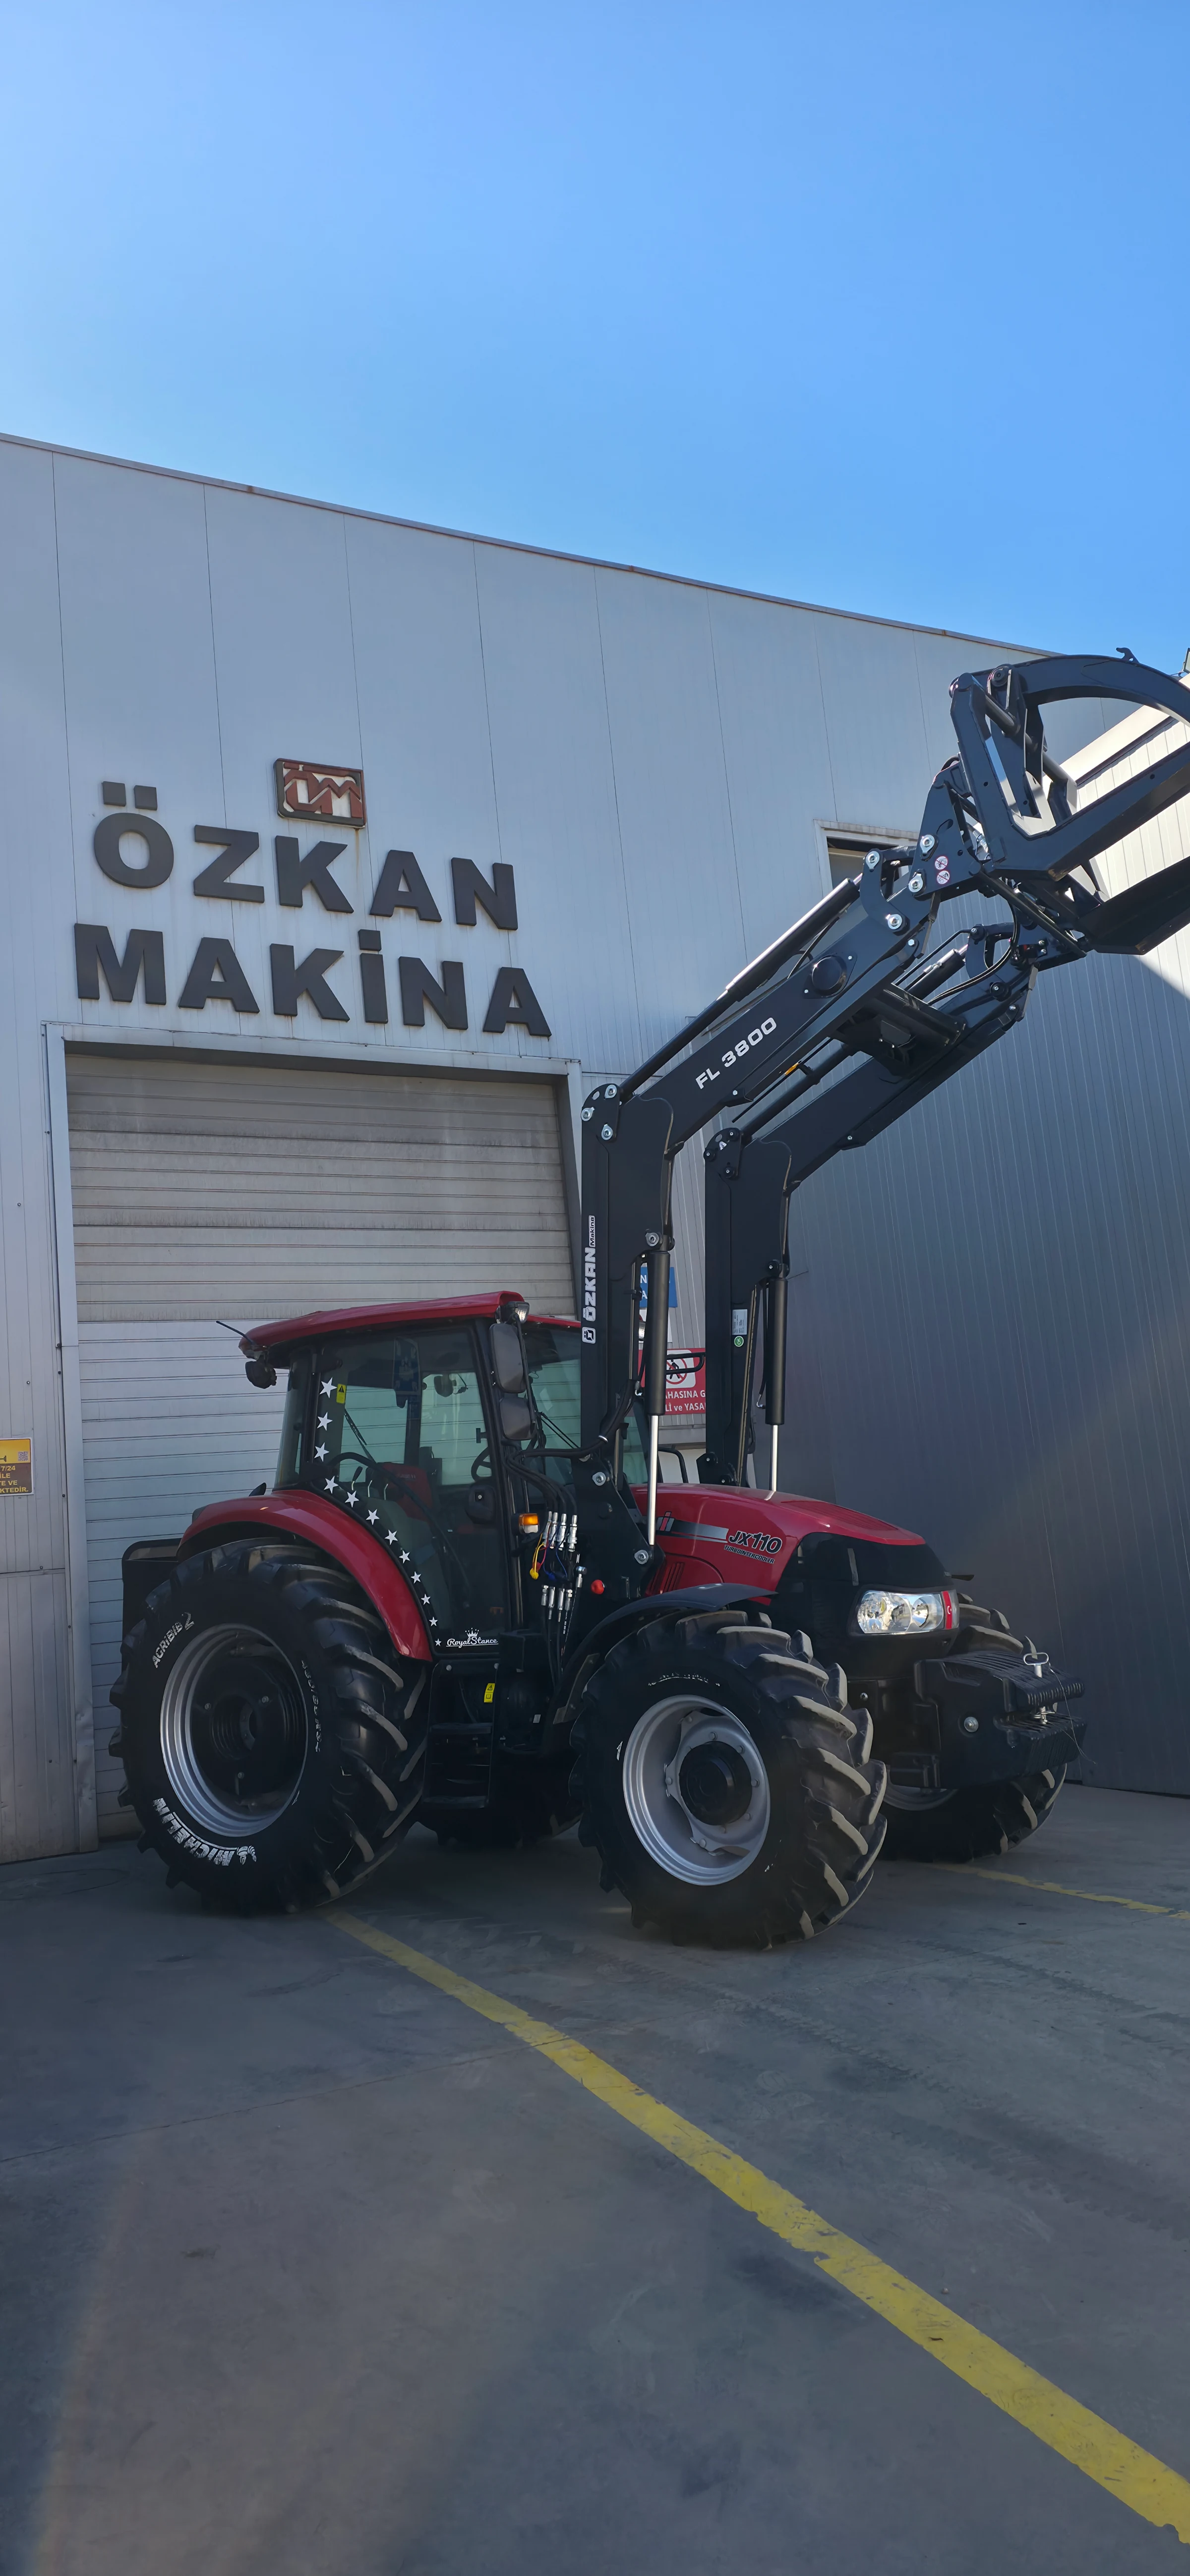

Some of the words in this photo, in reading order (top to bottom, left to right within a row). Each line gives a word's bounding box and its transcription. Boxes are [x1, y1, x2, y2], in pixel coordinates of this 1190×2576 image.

[94, 781, 518, 931] ÖZKAN
[74, 922, 552, 1037] MAKİNA
[695, 1068, 720, 1089] FL
[721, 1017, 777, 1068] 3800
[583, 1247, 596, 1322] ÖZKAN
[684, 1402, 706, 1411] YASA
[724, 1545, 775, 1564] TURBOINTERCOOLER
[728, 1530, 782, 1554] JX110
[152, 1797, 236, 1866] MICHELIN
